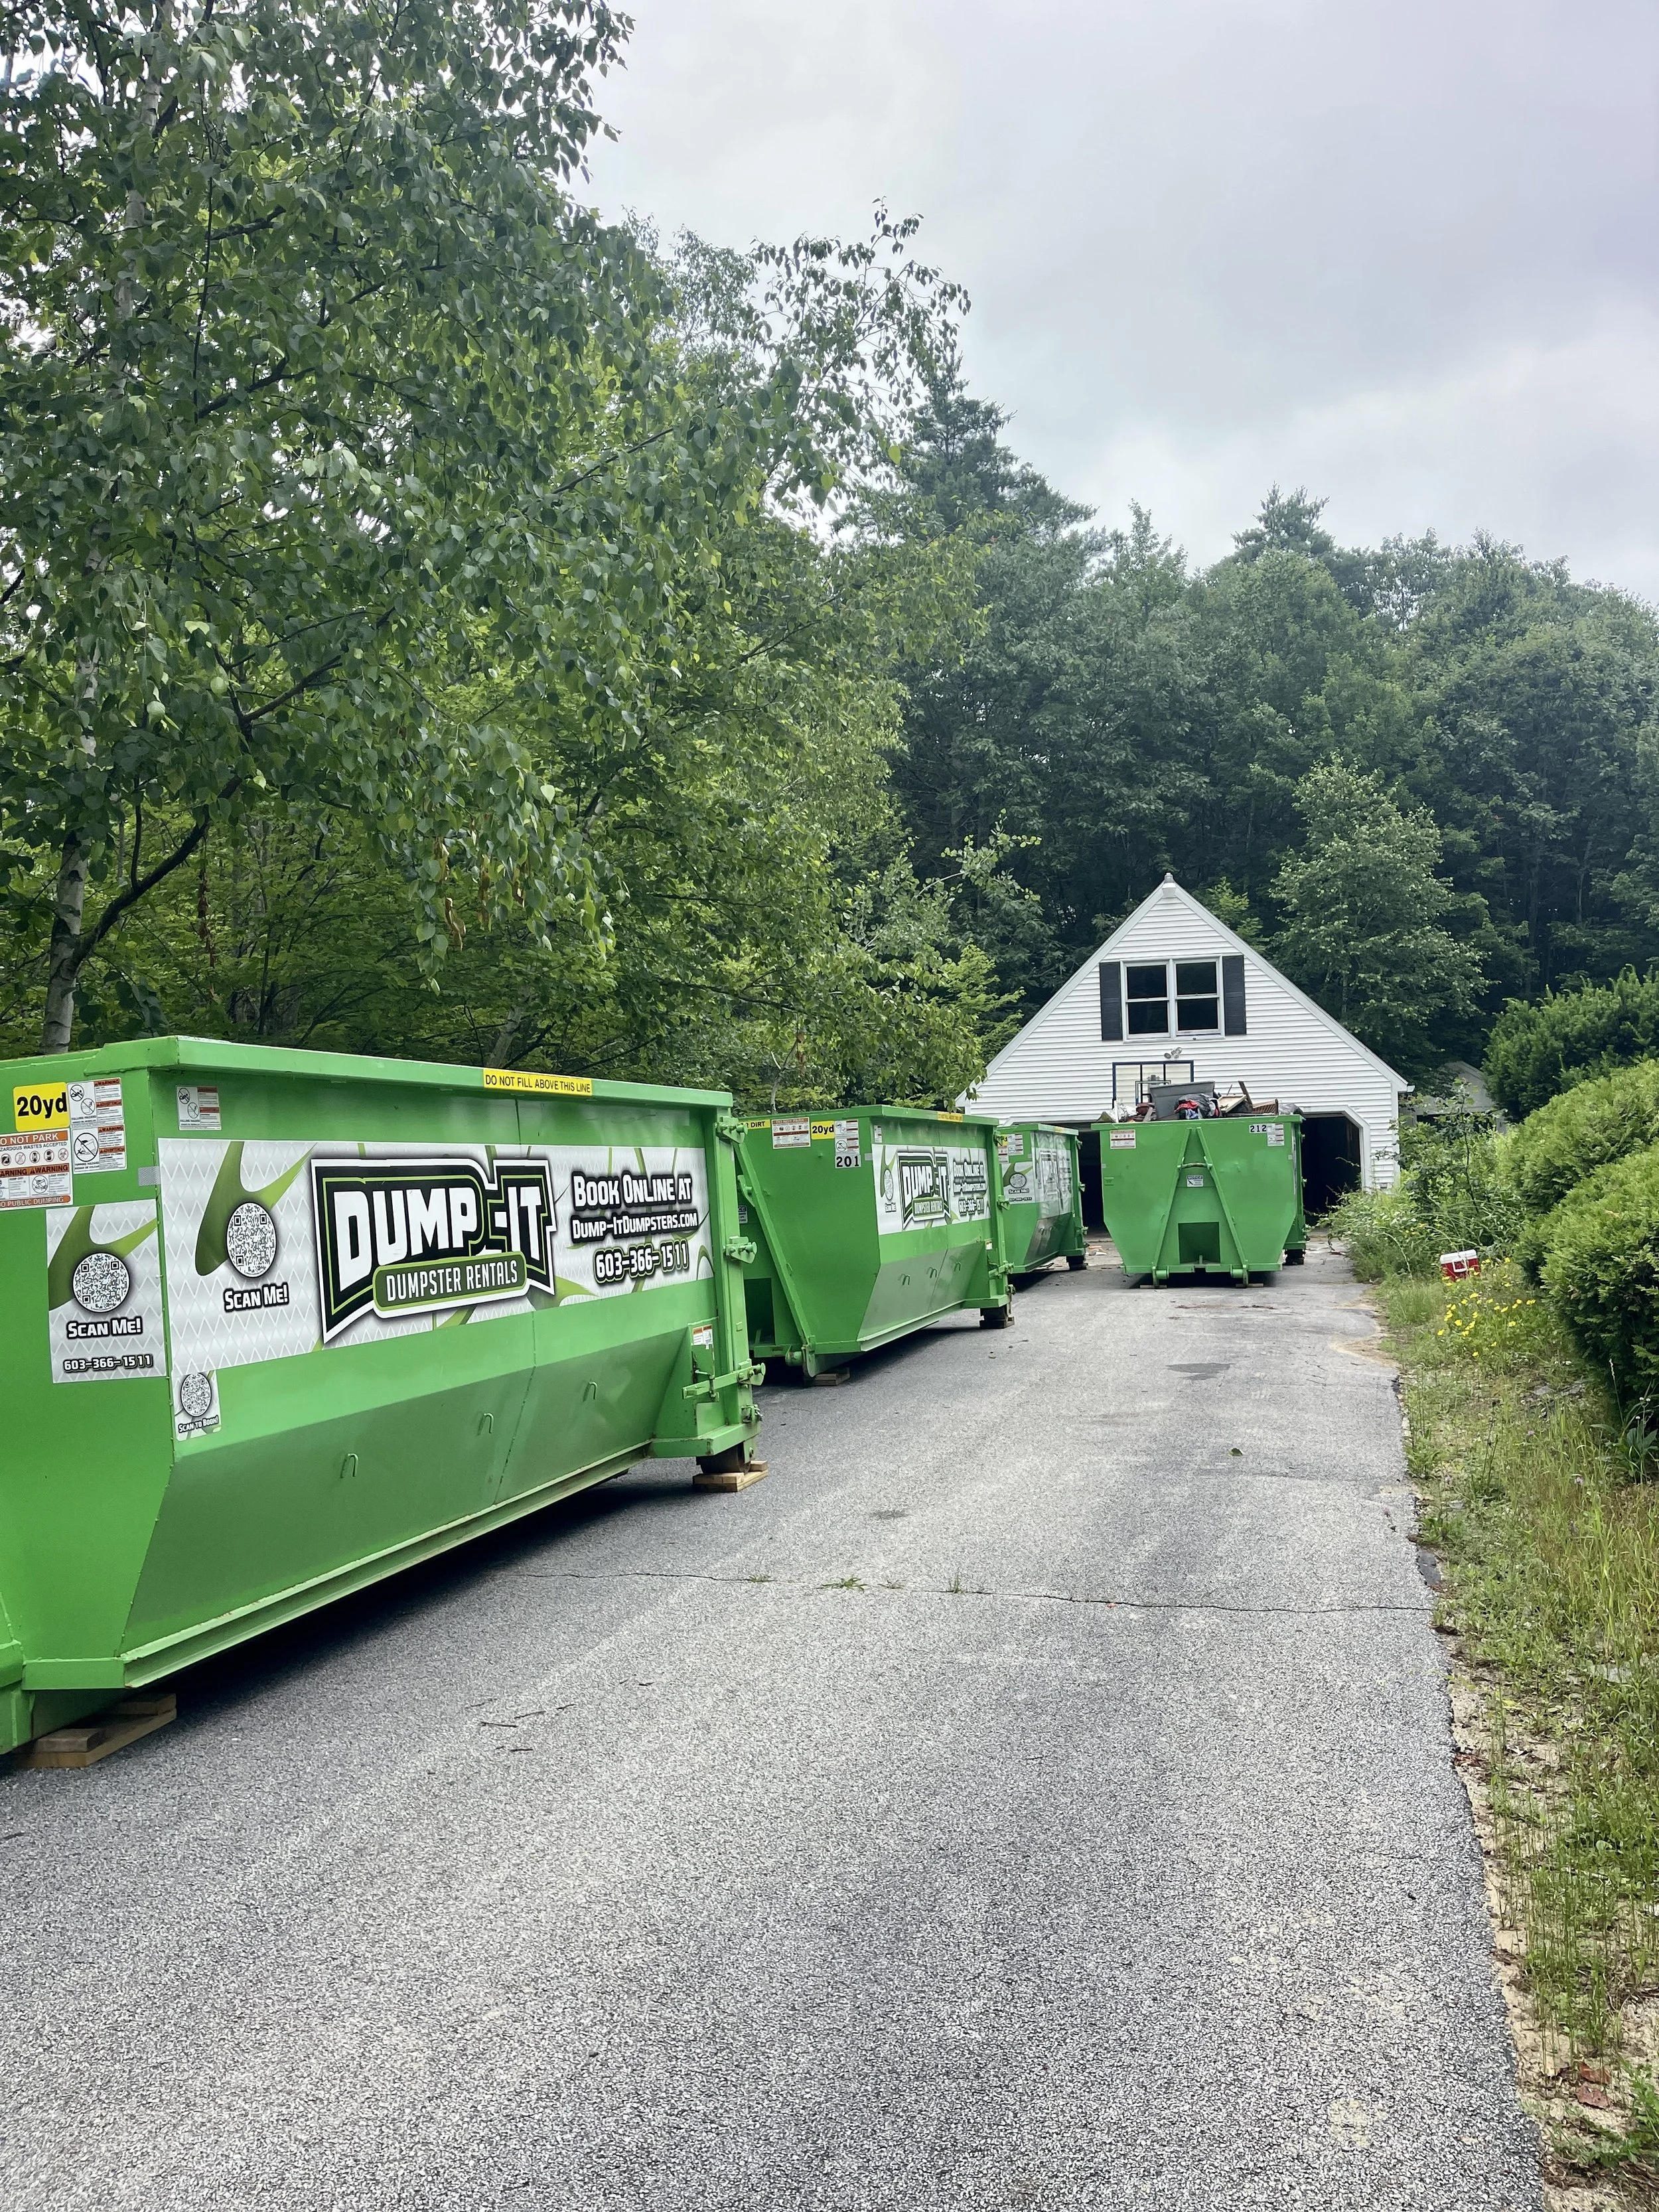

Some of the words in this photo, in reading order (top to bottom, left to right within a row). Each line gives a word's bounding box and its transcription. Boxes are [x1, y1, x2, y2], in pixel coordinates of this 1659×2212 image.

[485, 1074, 497, 1085] DO
[499, 1076, 515, 1086] NOT
[517, 1077, 533, 1088] FILL
[534, 1079, 559, 1090] ABOVE
[559, 1080, 575, 1092] THIS
[576, 1082, 591, 1093] LINE
[17, 1092, 68, 1119] 20yd
[10, 1135, 30, 1144] NOT
[33, 1133, 59, 1142] PARK
[812, 1124, 834, 1135] 20yd
[836, 1155, 859, 1167] 201
[0, 1169, 27, 1177] ARNING
[35, 1165, 68, 1173] WARNING
[902, 1165, 948, 1209] DUMP-IT
[334, 1186, 542, 1292] DUMP-IT
[596, 1243, 687, 1278] 603-366-1511
[386, 1267, 461, 1301] DUMPSTER
[466, 1260, 518, 1288] RENTALS
[64, 1355, 151, 1370] 603-366-1511
